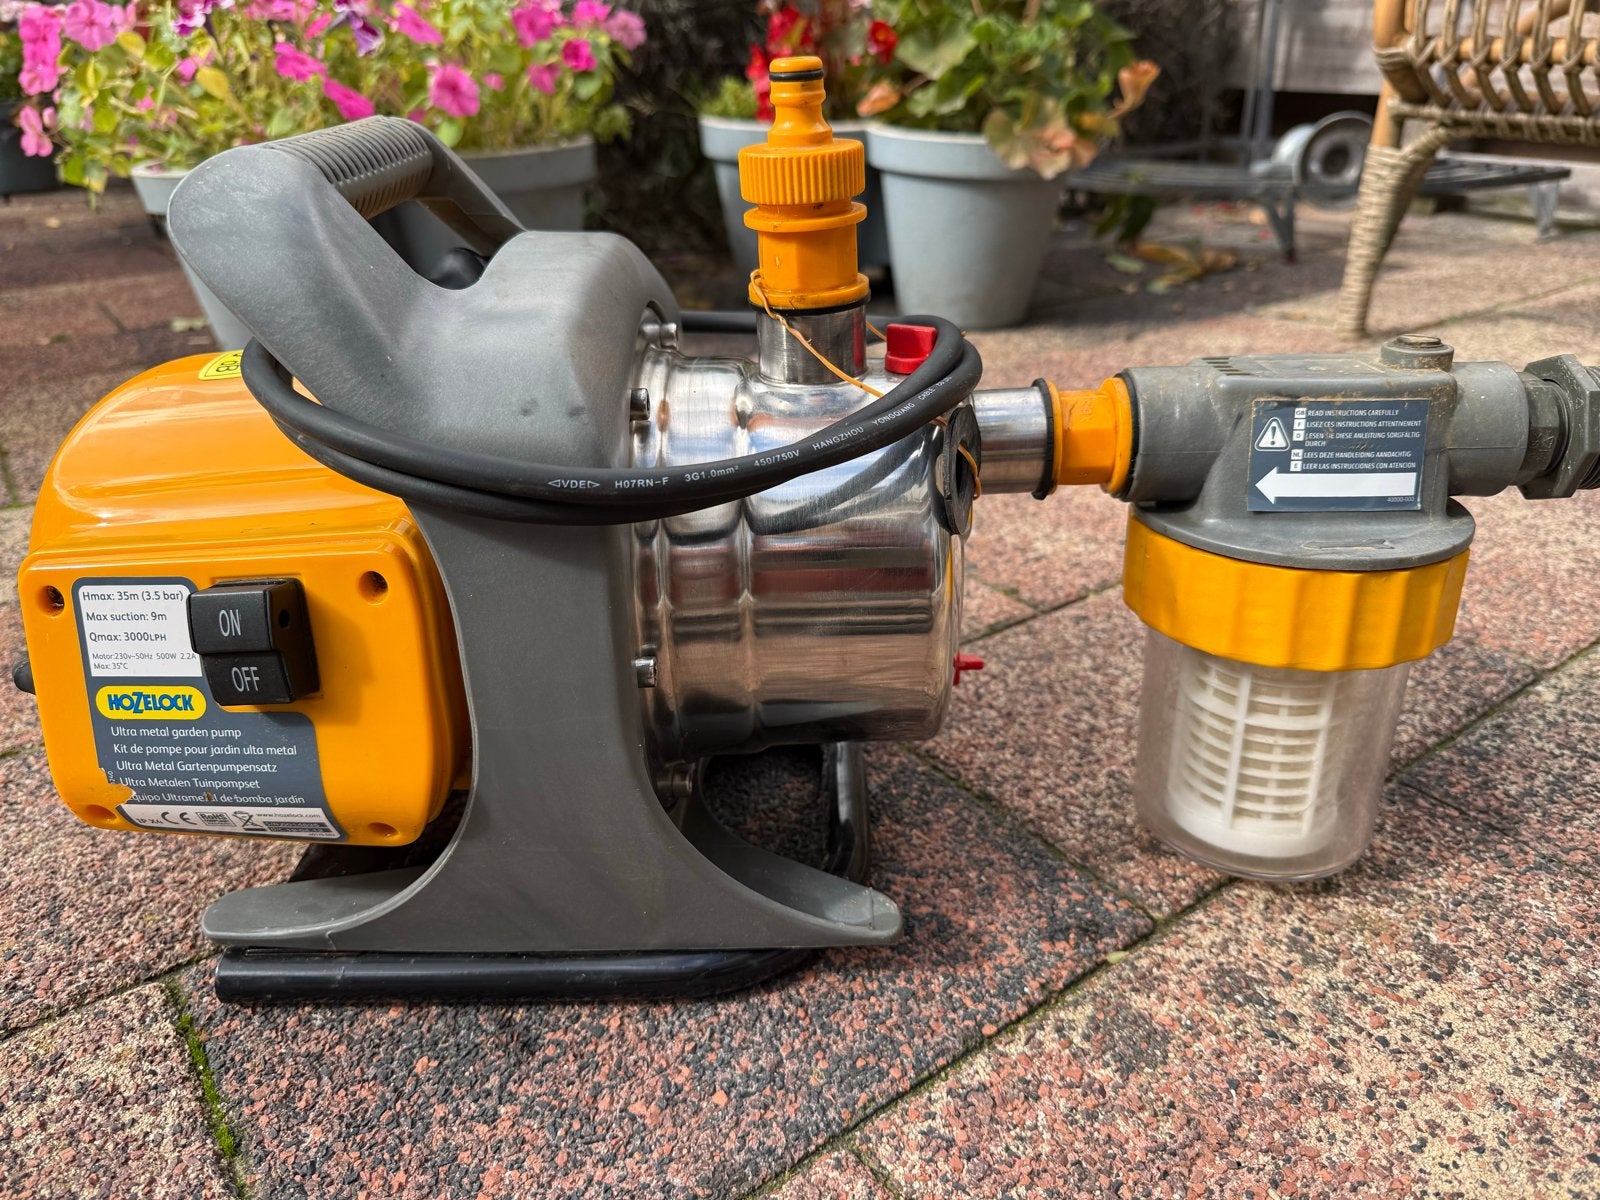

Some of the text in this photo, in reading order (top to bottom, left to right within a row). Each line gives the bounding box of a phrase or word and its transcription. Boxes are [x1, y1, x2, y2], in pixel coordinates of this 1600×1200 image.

[614, 476, 670, 489] H07RN-F
[753, 448, 800, 468] 450/750V
[812, 426, 865, 451] HANGZHOU
[872, 402, 916, 426] YONGQIANG
[82, 591, 184, 602] Hmax: 35m (3.5 bar)
[86, 612, 167, 621] Max suction: 9m
[219, 610, 242, 636] ON
[90, 632, 166, 642] Qmax: 3000LPH
[112, 662, 128, 670] 35°C
[232, 667, 260, 692] OFF
[108, 692, 194, 714] HOZELOCK
[111, 726, 242, 740] Ultra metal garden pump
[114, 744, 297, 757] Kit de pompe pour jardin ulta metal
[116, 760, 277, 774] Ultra Metal Gartenpumpensatz
[120, 777, 146, 787] Ultra
[148, 778, 190, 788] Metalen
[192, 778, 260, 791] Tuinpompset
[131, 793, 161, 803] quipo
[220, 794, 234, 802] de
[235, 794, 272, 804] bomba
